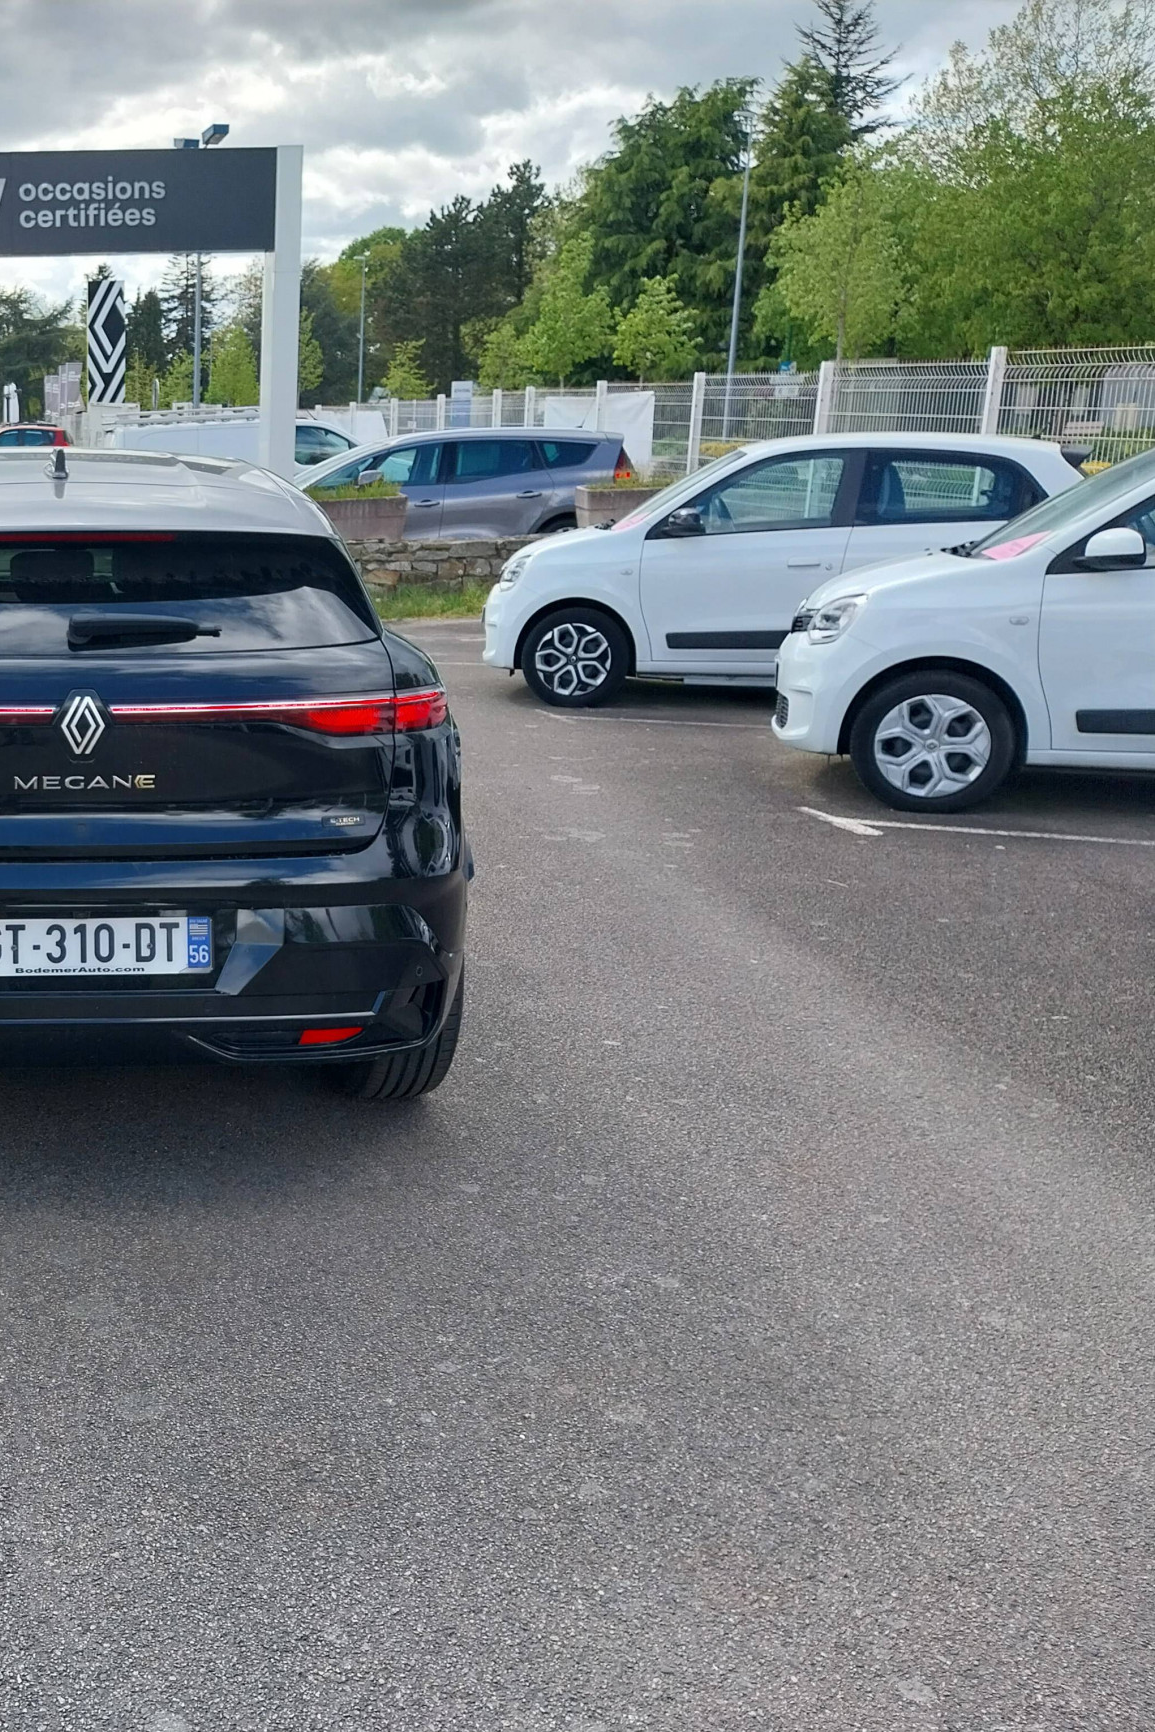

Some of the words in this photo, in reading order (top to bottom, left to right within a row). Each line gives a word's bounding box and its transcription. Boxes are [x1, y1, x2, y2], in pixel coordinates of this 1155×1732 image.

[19, 176, 166, 201] occasions
[19, 202, 156, 228] certifiées
[14, 774, 156, 790] MEGANE
[189, 945, 209, 963] 56
[15, 965, 145, 974] BodemerAuto.com
